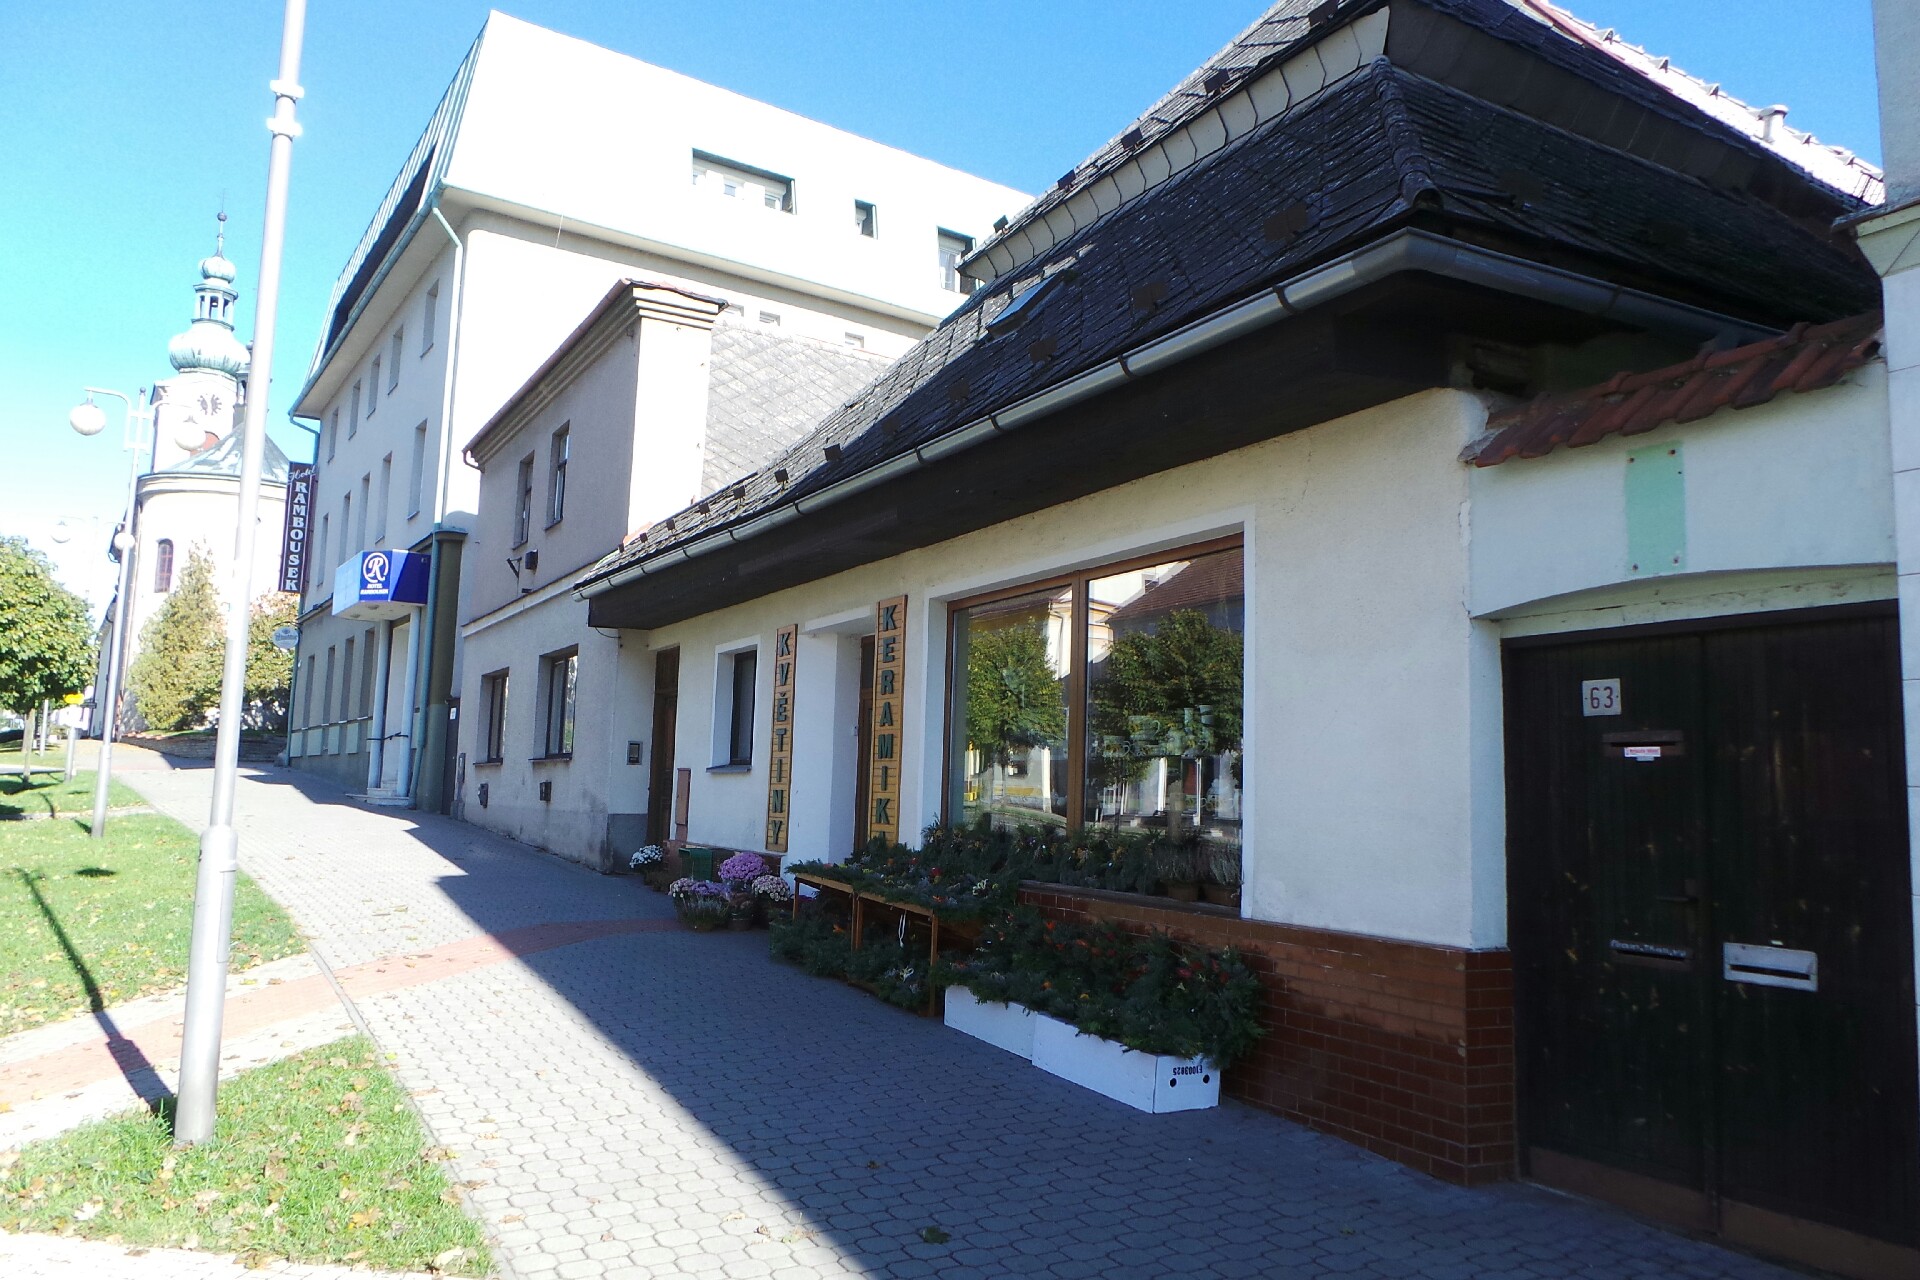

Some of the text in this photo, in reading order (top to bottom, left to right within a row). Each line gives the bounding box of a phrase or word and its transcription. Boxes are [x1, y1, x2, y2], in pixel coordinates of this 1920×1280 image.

[289, 464, 316, 481] Hotel
[284, 480, 309, 591] RAMBOUSEK
[1590, 686, 1614, 709] 63
[770, 632, 791, 845] KVĚTINY
